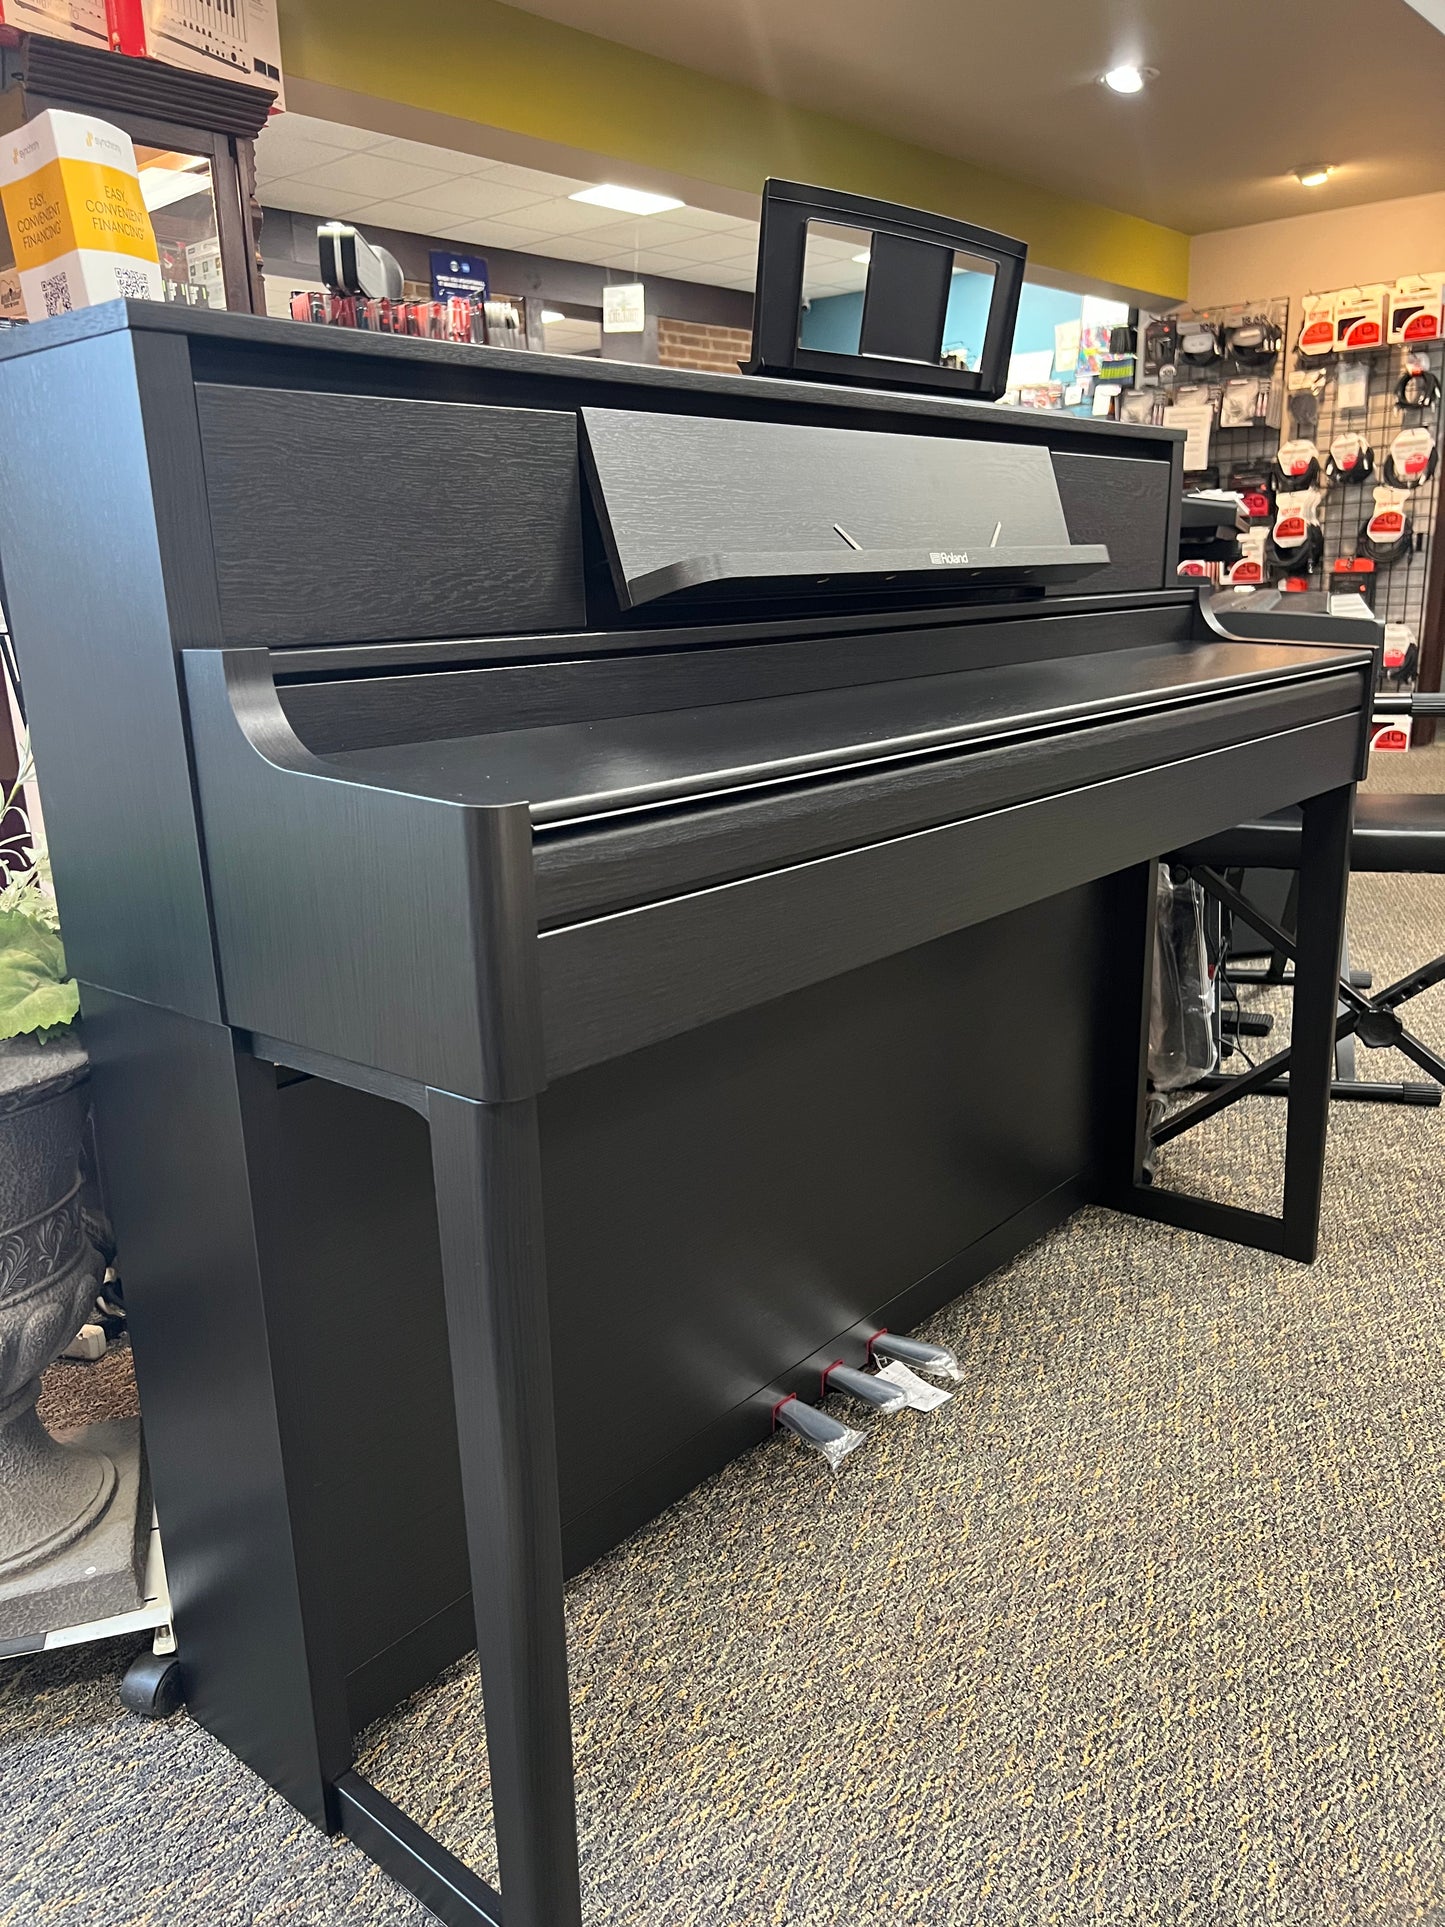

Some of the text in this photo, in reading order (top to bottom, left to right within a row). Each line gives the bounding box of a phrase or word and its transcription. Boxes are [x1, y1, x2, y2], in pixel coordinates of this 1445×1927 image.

[104, 185, 128, 205] EASY,
[17, 202, 61, 233] CONVENIENT
[85, 199, 144, 224] CONVENIENT
[940, 551, 969, 565] Roland
